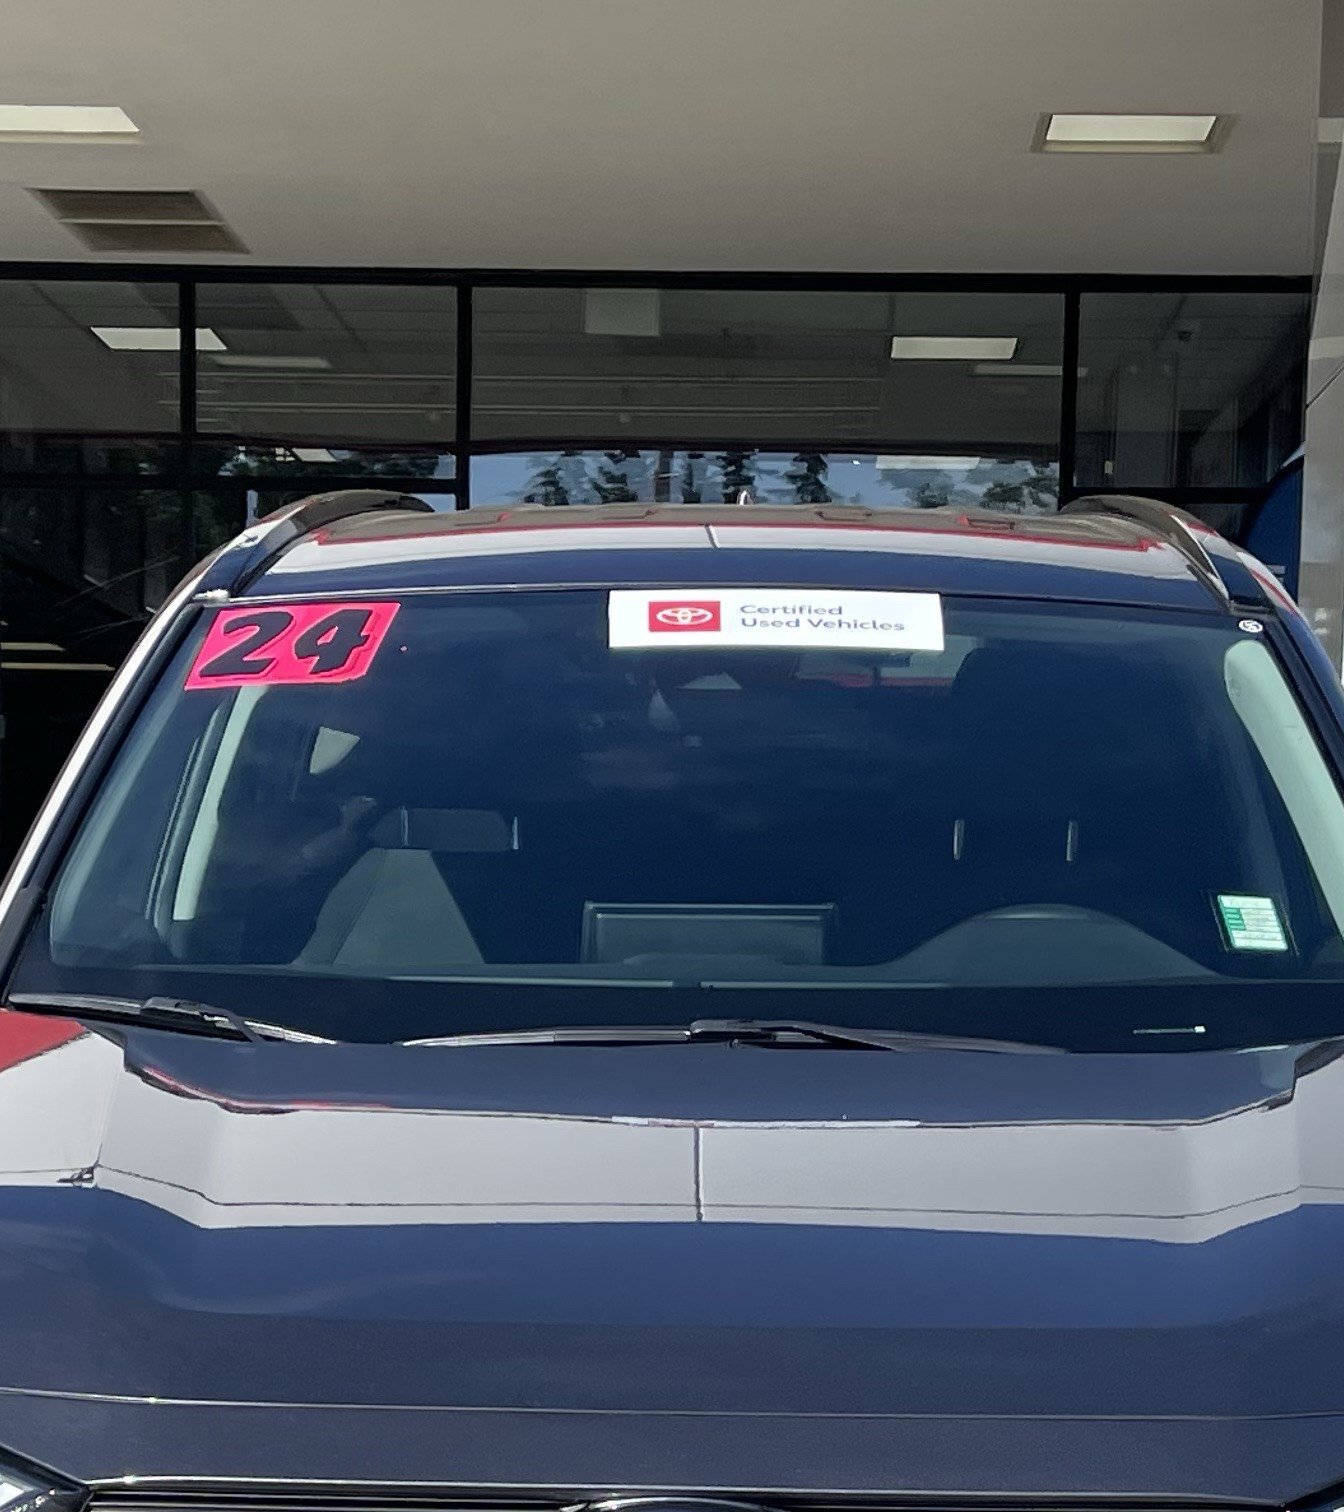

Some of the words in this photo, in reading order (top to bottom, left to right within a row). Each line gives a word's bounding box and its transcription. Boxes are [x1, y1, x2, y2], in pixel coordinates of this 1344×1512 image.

[739, 604, 843, 616] Certified
[740, 617, 801, 629] Used
[807, 618, 906, 632] Vehicles
[199, 609, 373, 677] 24
